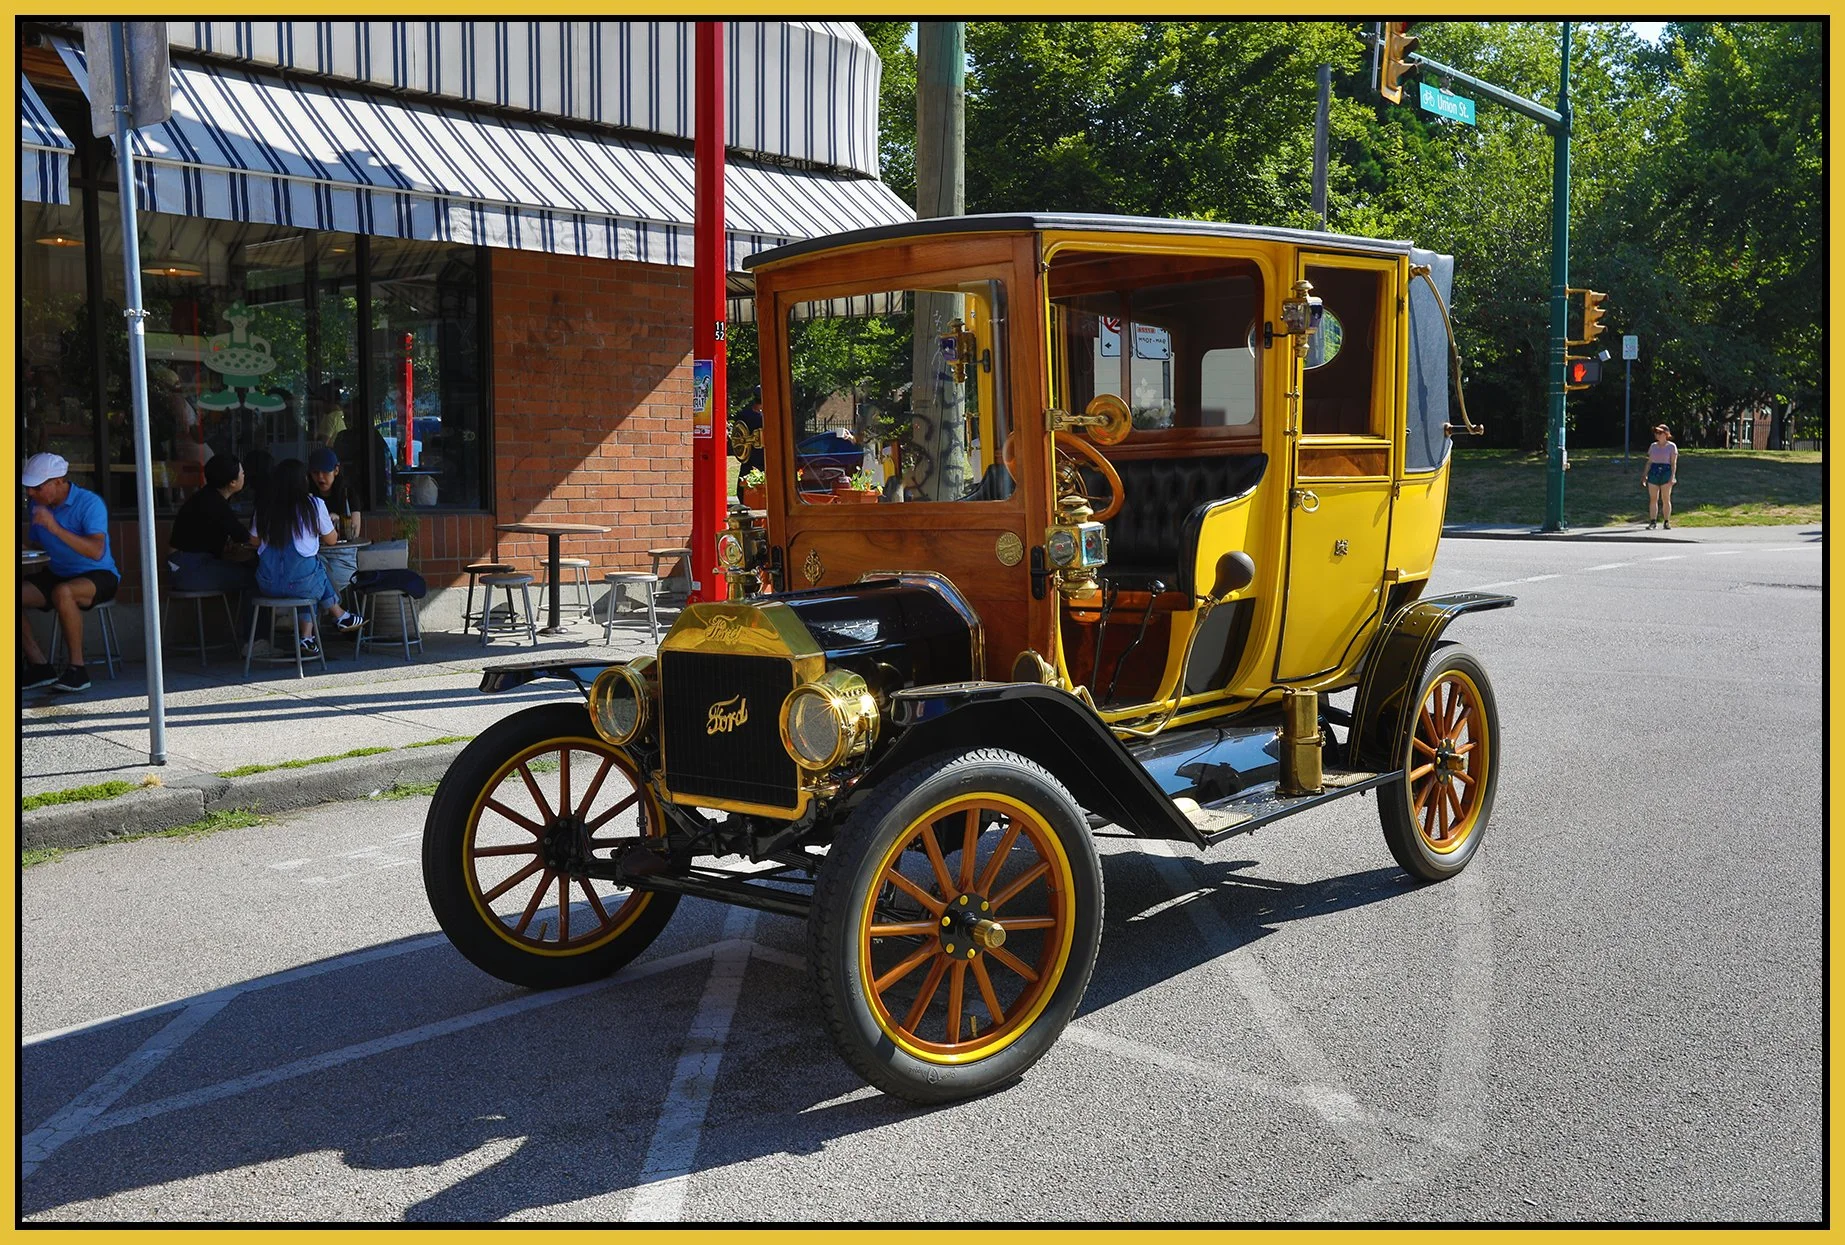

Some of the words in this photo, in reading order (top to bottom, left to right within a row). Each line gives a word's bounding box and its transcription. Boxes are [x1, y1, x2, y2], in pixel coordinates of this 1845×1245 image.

[1437, 94, 1457, 114] Union
[1458, 101, 1469, 119] St.
[715, 321, 725, 331] 11
[715, 330, 725, 340] 52
[705, 614, 743, 646] Ford
[706, 694, 748, 735] Ford
